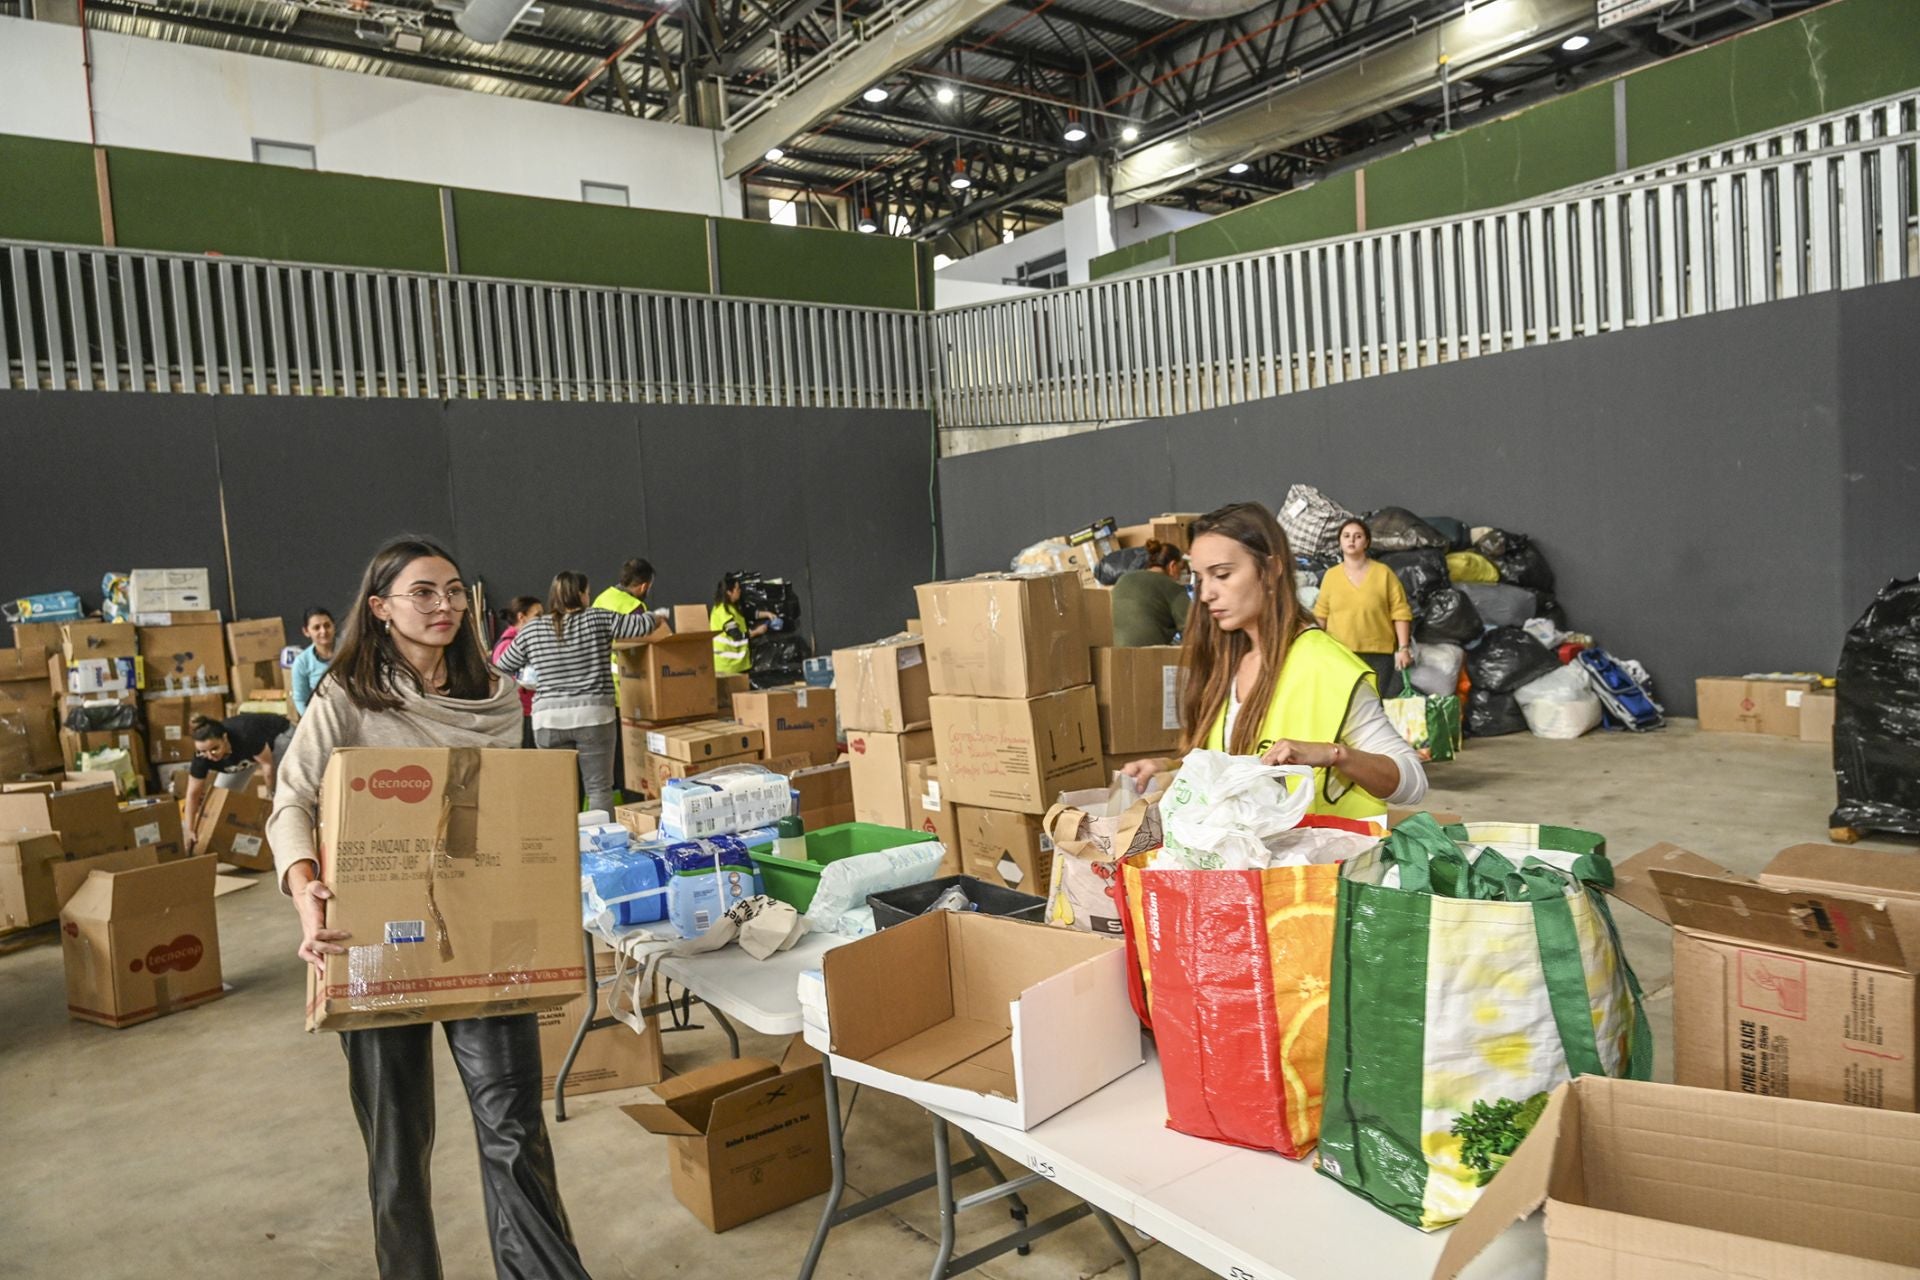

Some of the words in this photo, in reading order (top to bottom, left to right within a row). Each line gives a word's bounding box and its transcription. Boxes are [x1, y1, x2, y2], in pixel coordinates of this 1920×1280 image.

[371, 778, 431, 790] tecnocop
[371, 839, 410, 854] PANZANI
[148, 945, 202, 966] tecnocop
[427, 978, 457, 988] Twist
[1739, 1019, 1756, 1051] SLICE
[1740, 1052, 1756, 1094] CHEESE
